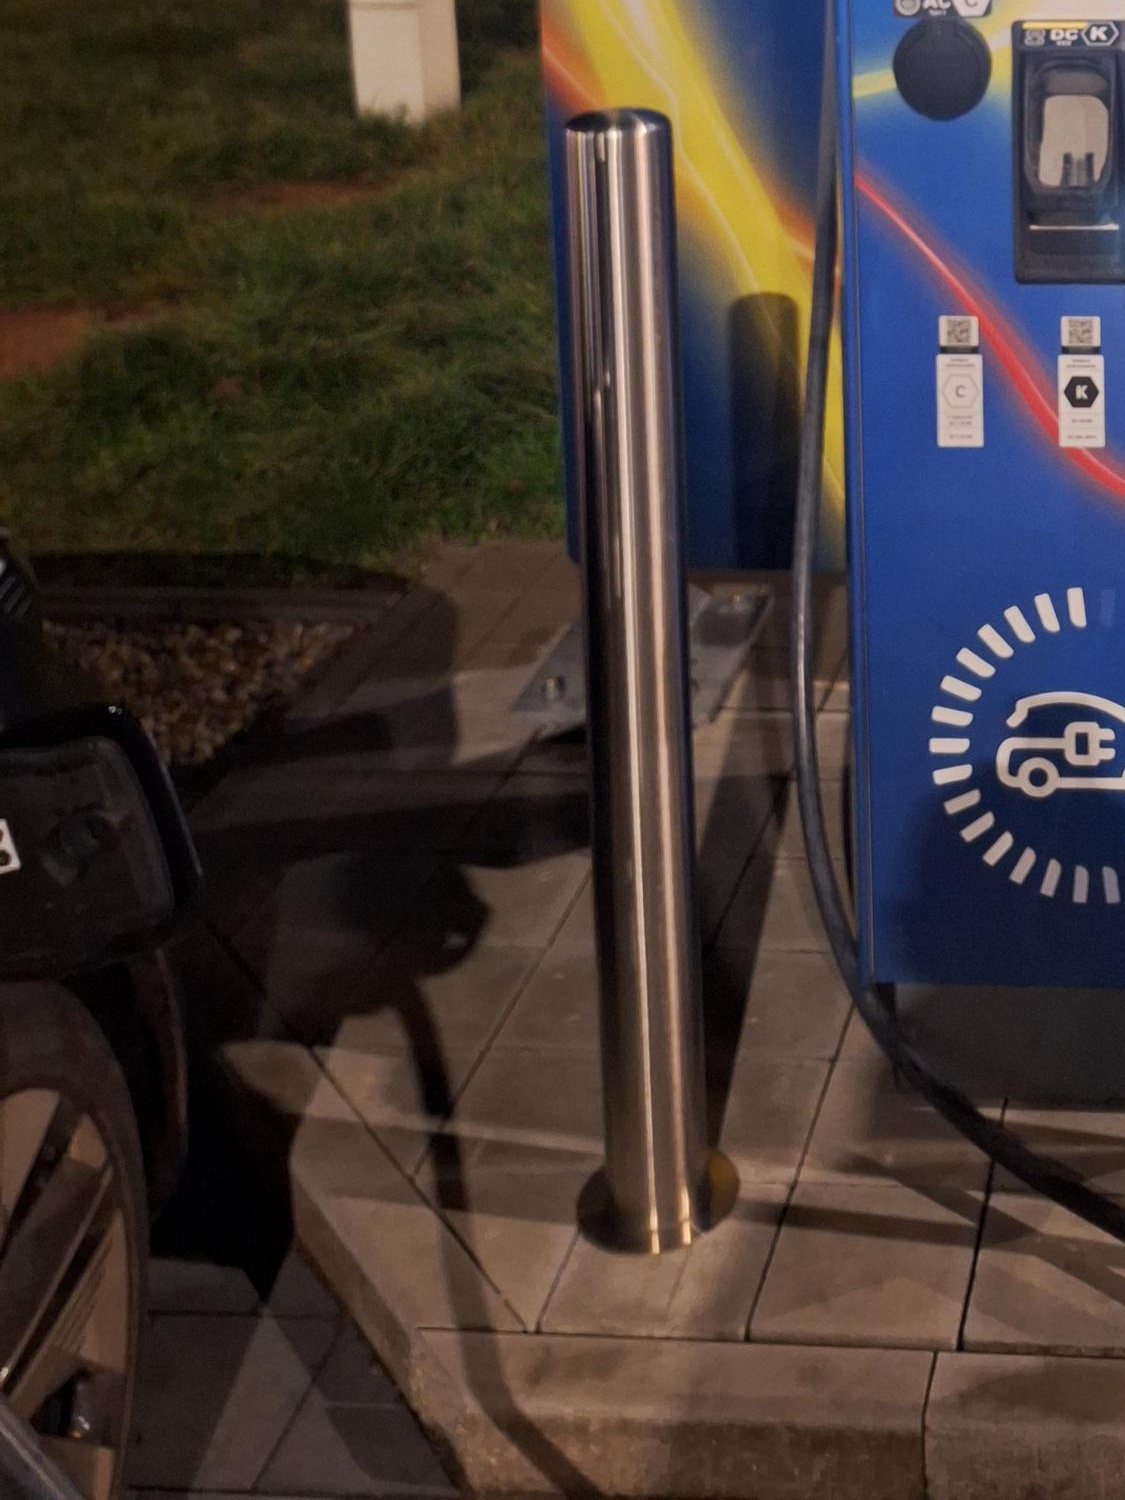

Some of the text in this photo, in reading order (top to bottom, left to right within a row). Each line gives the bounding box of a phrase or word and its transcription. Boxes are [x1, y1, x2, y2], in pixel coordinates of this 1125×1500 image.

[1049, 25, 1108, 42] DC K
[955, 384, 966, 399] C
[1074, 384, 1088, 400] K
